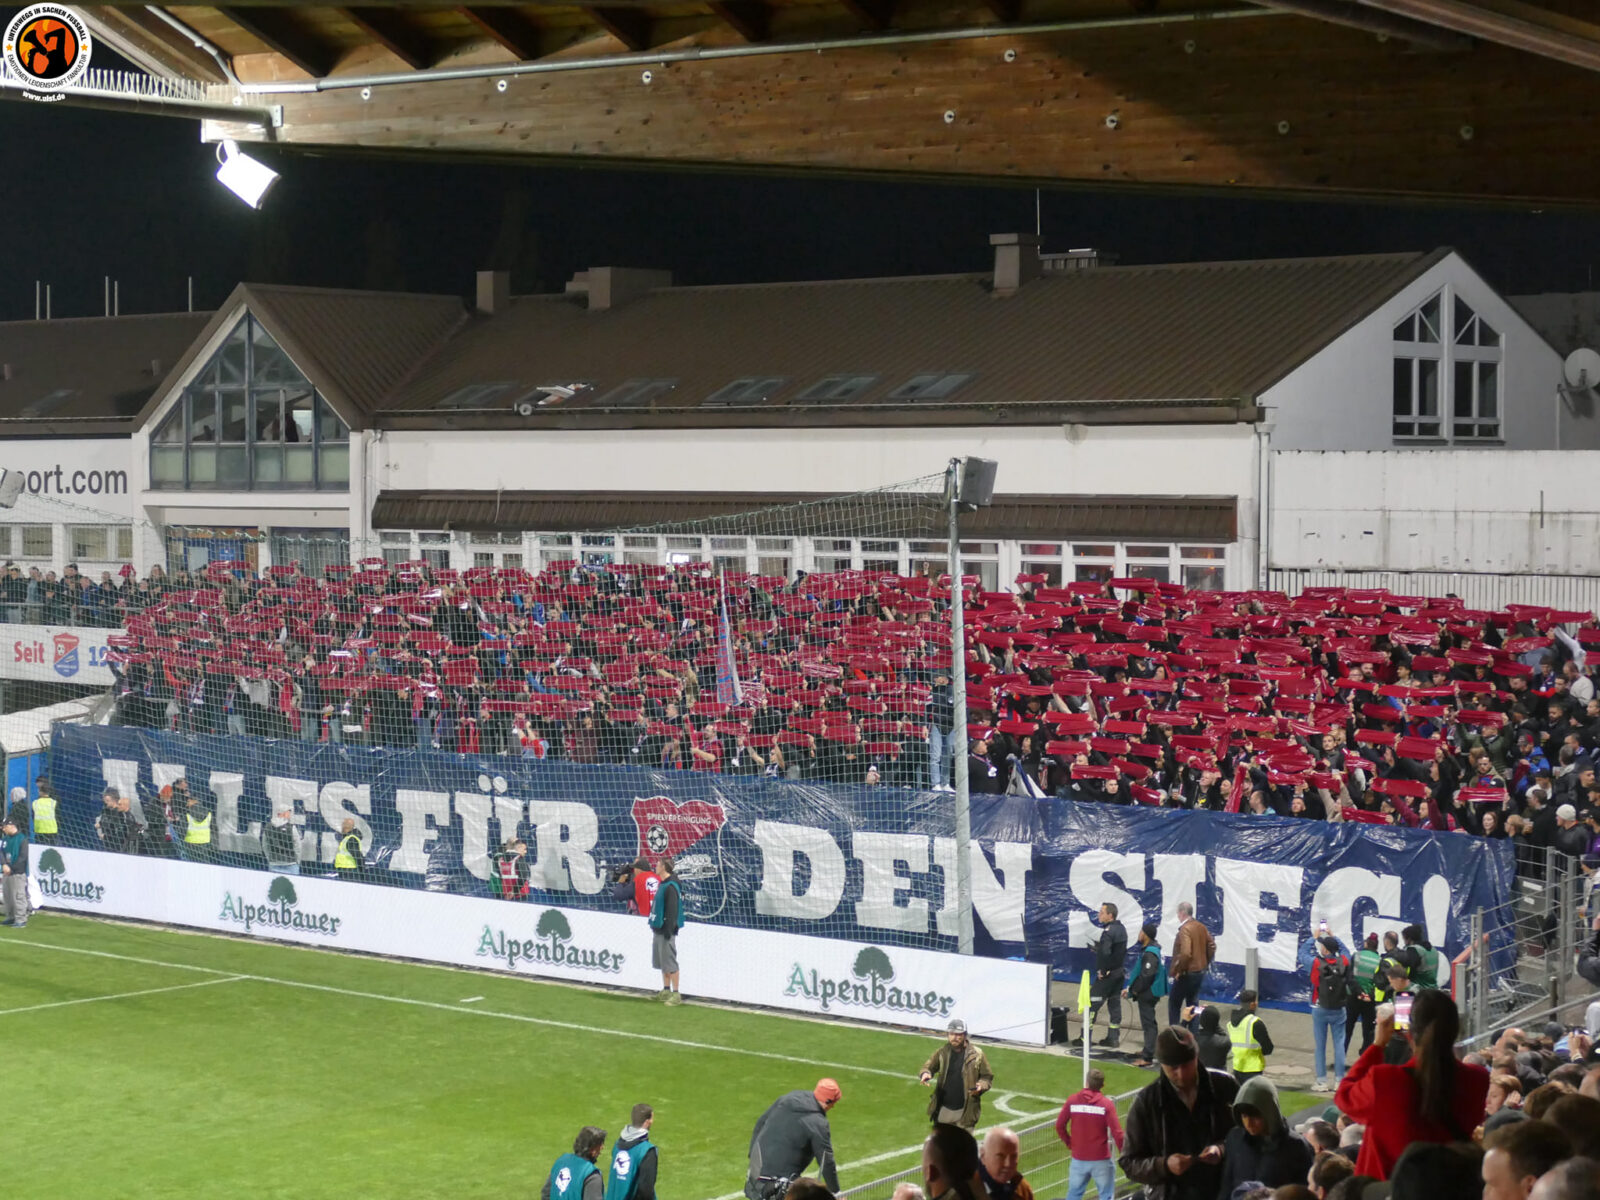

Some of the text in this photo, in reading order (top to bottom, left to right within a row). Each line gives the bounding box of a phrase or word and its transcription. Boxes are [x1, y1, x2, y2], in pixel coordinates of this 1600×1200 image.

[14, 640, 45, 664] Seit
[389, 774, 605, 894] FÜR
[754, 820, 1033, 942] DEN
[219, 891, 341, 933] Alpenbauer
[477, 925, 625, 971] Alpenbauer
[785, 963, 954, 1016] Alpenbauer
